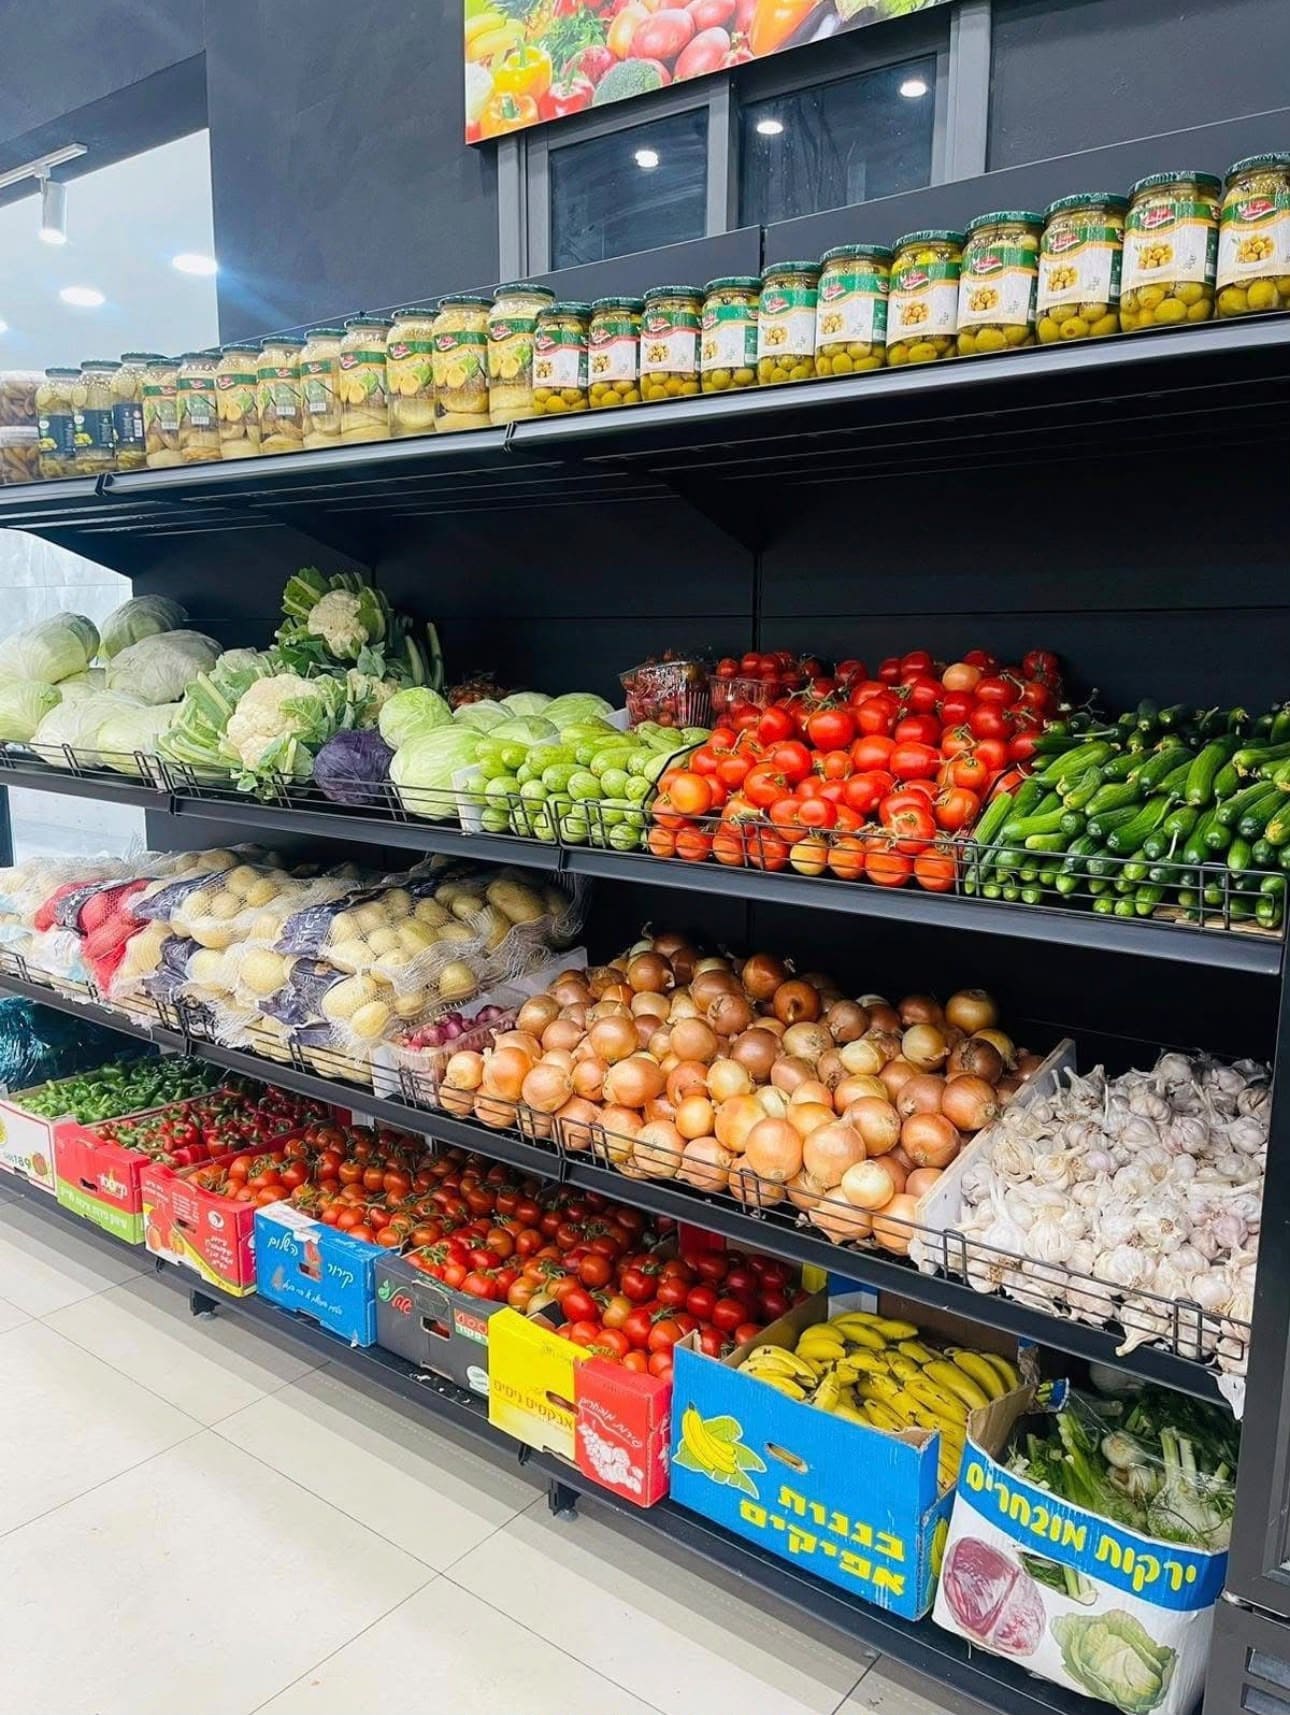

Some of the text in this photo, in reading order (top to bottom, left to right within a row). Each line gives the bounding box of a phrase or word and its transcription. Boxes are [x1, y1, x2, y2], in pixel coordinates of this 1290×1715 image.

[267, 1231, 354, 1288] קירור השלום
[739, 1498, 905, 1596] אפיקים
[778, 1484, 905, 1562] בננות
[965, 1461, 1198, 1592] ירקות מובחרים
